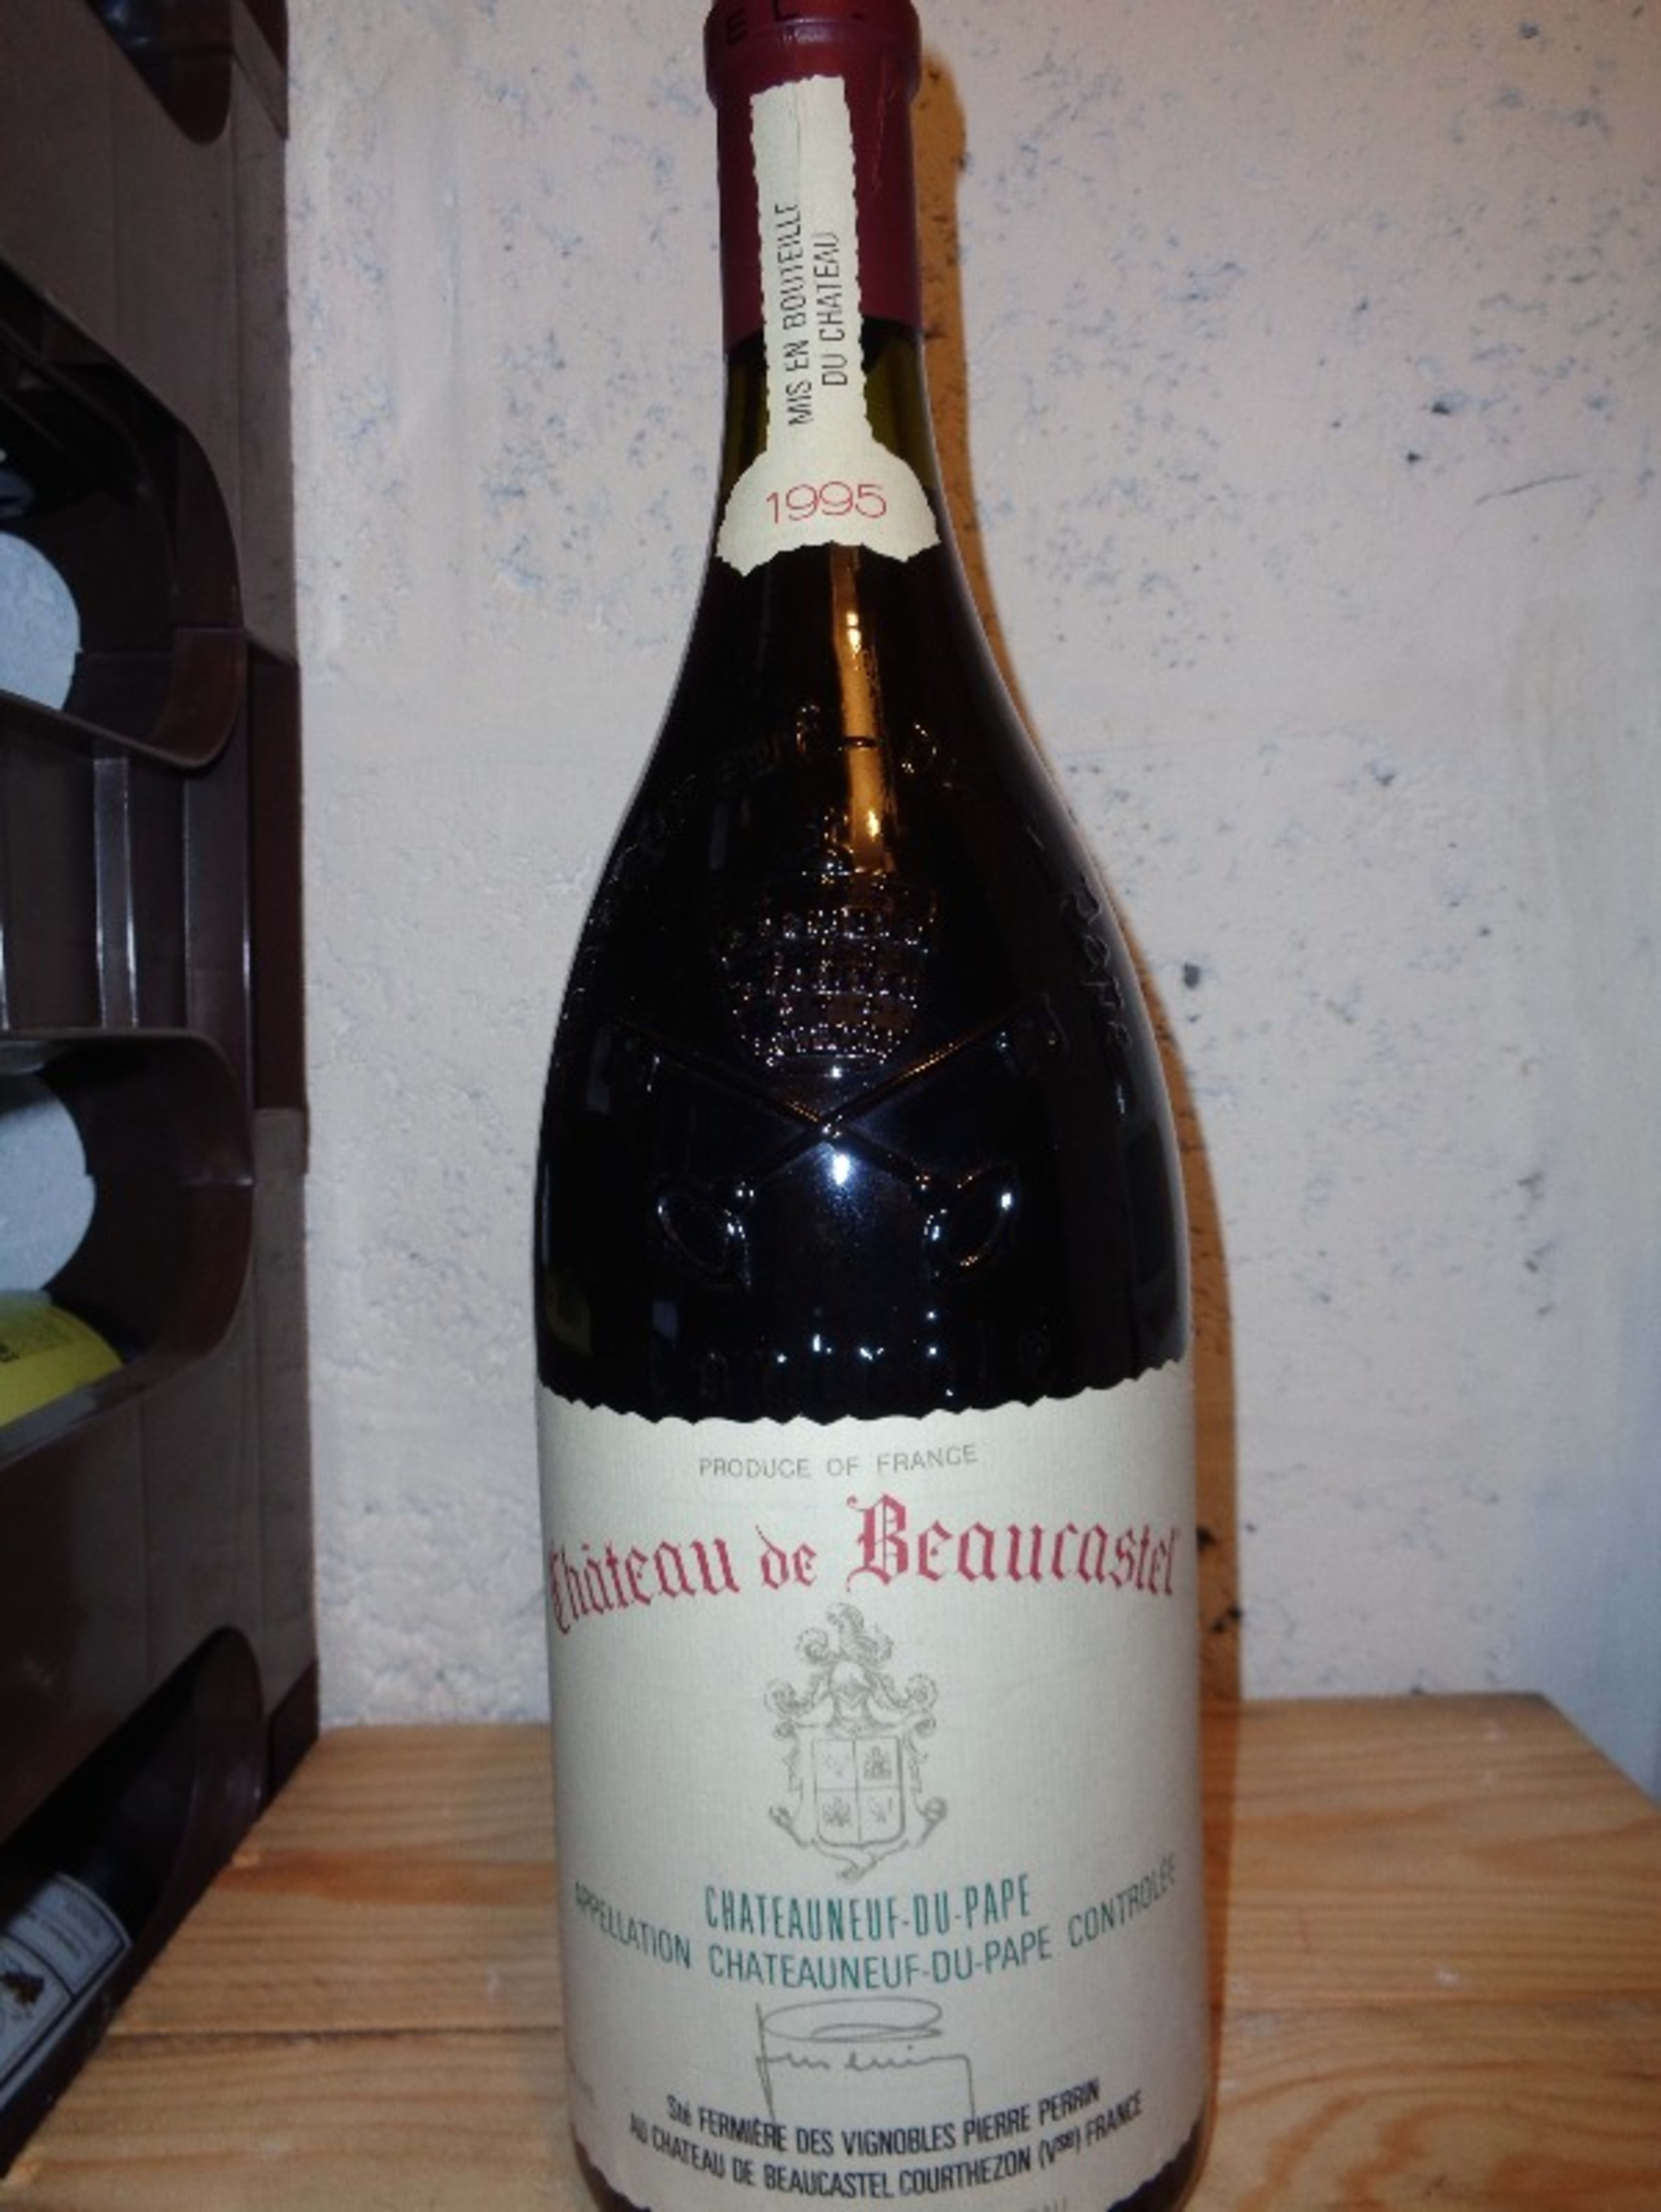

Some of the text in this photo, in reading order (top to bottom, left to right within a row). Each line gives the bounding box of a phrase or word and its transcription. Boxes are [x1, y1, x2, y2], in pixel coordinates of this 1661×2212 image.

[775, 202, 814, 426] MIS EN BOUTEILLE
[812, 232, 849, 387] DU CHATEAU
[766, 480, 887, 524] 1995
[699, 1443, 978, 1479] PRODUCE OF FRANCE
[550, 1493, 1178, 1635] Château de Beaucastel
[574, 1881, 692, 1970] APPELLATION
[708, 1925, 1052, 1991] CHATEAUNEUF-DU-PAPE
[705, 1872, 1031, 1942] CHATEAUNEUF-DU-PAPE
[629, 2111, 648, 2145] AU
[651, 2124, 725, 2179] CHATEAU
[733, 2156, 756, 2187] DE
[763, 2162, 895, 2199] BEAUCASTEL
[899, 2146, 1032, 2197] COURTHEZON
[1085, 2089, 1143, 2146] FRANCE
[698, 2106, 788, 2152] FERMIÈRE
[796, 2126, 834, 2157] DES
[842, 2122, 956, 2157] VIGNOBLES
[963, 2102, 1032, 2146] PIERRE
[1039, 2075, 1100, 2126] PERRIN
